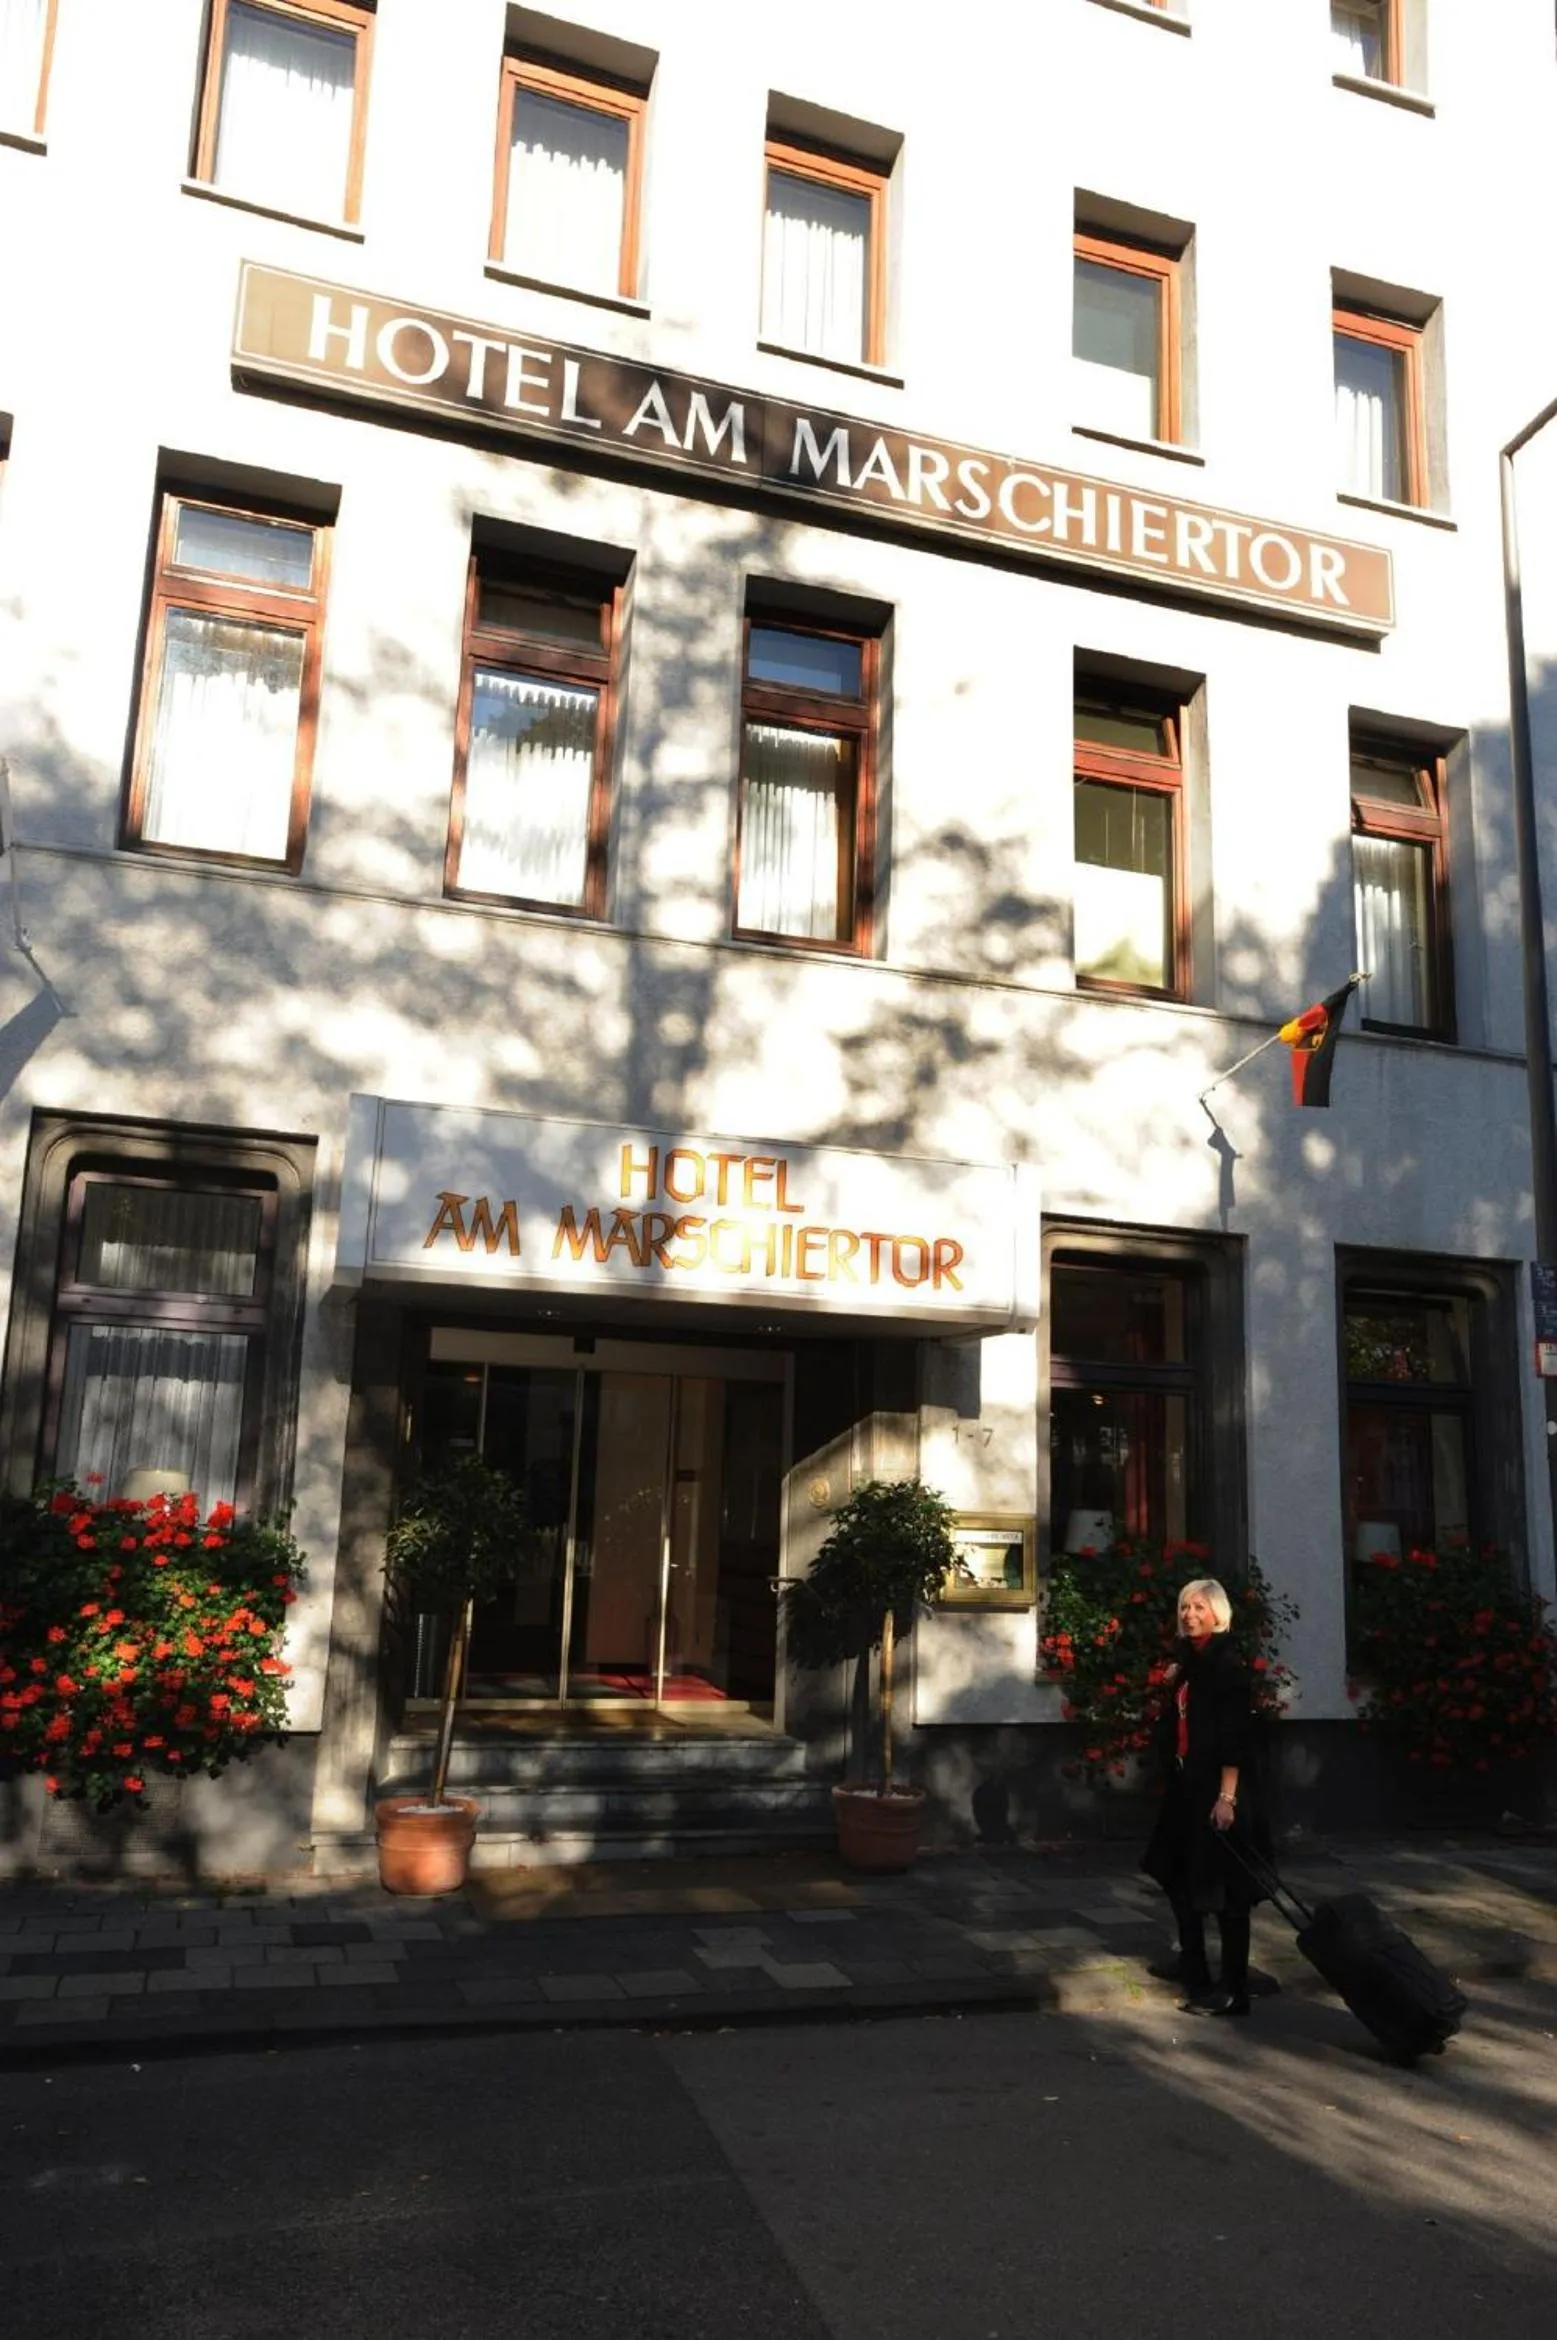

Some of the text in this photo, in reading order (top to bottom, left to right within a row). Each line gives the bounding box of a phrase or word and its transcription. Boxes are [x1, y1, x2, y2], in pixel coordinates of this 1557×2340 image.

[308, 293, 1351, 606] HOTEL AM MARSCHIERTOR
[619, 1143, 806, 1213] HOTEL
[422, 1190, 965, 1291] AM MARSCHIERTOR
